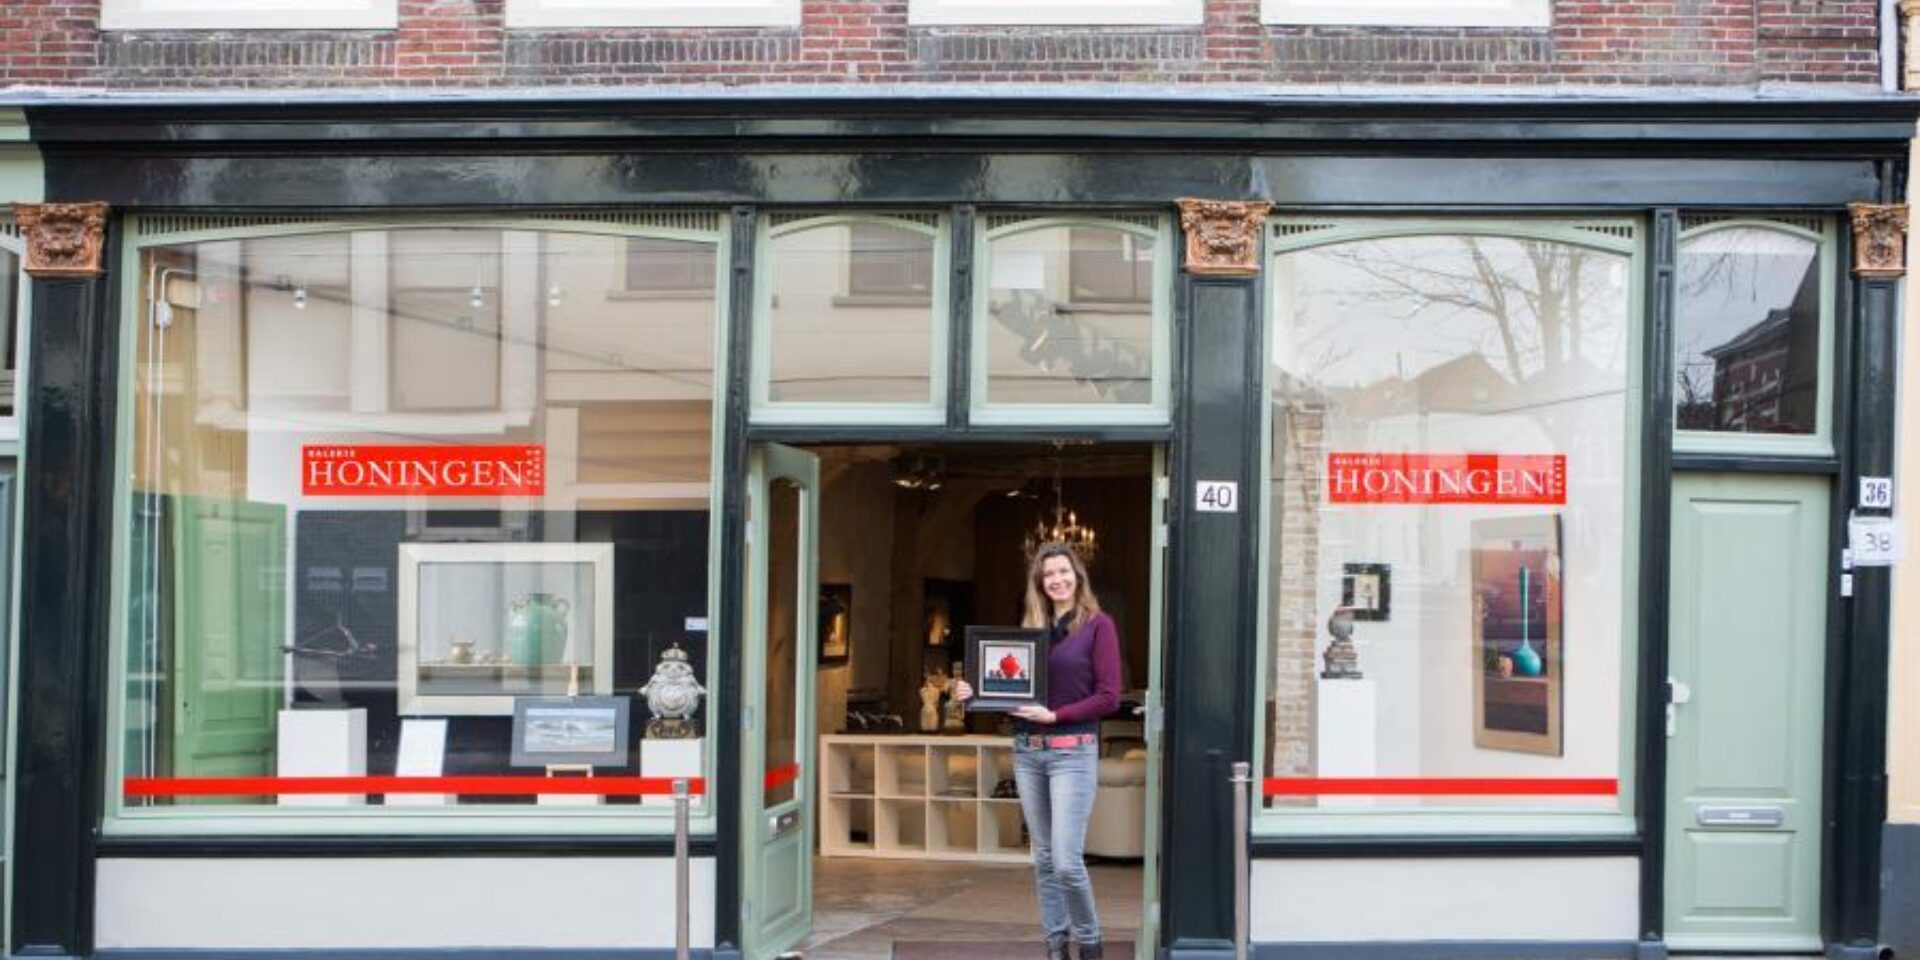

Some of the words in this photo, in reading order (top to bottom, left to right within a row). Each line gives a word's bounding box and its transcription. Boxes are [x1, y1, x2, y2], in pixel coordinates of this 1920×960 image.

[309, 460, 522, 486] HONINGEN
[1335, 468, 1546, 495] HONINGEN
[1201, 485, 1231, 508] 40
[1866, 482, 1887, 503] 36
[1864, 532, 1890, 552] 38
